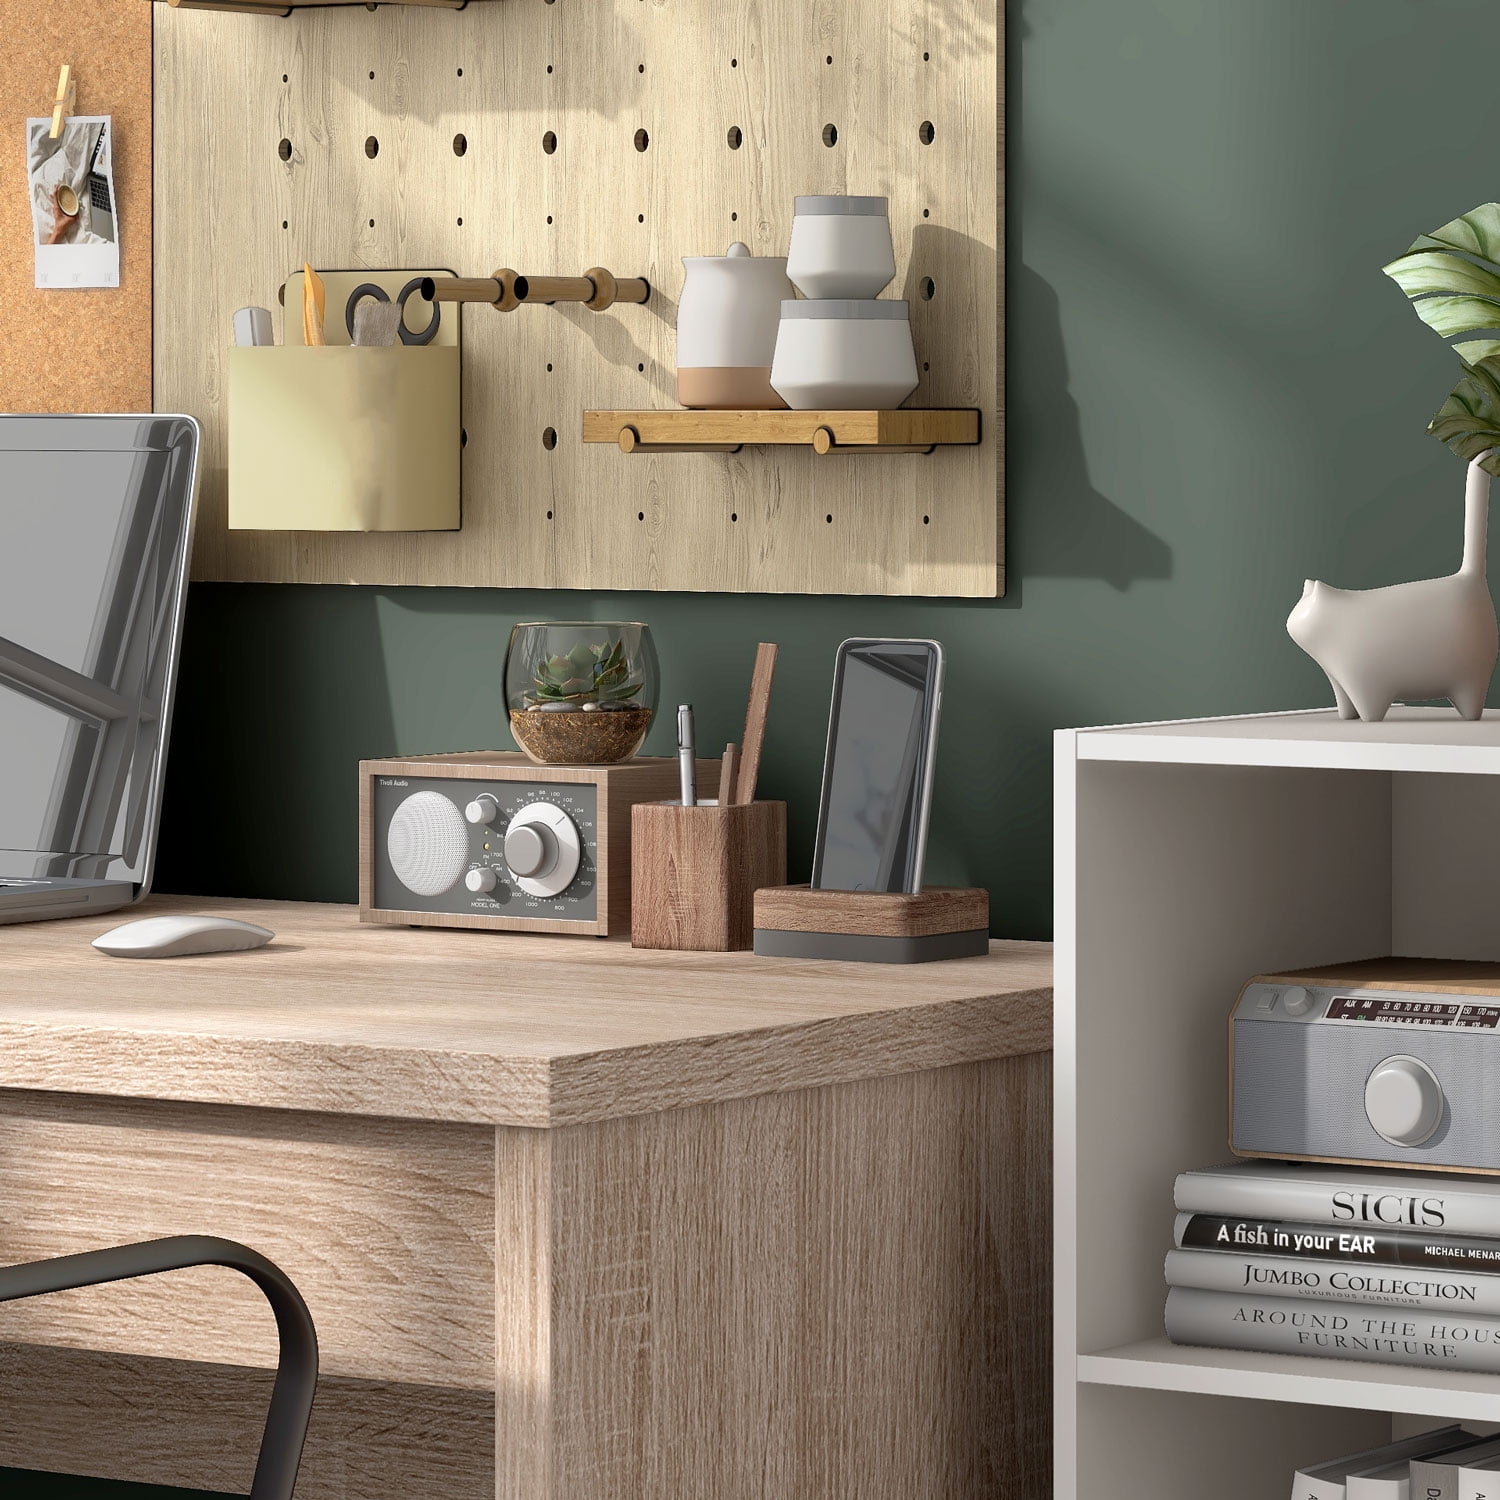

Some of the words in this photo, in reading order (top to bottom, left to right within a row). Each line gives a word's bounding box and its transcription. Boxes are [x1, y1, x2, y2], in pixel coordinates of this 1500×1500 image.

[1343, 1000, 1358, 1008] AUX
[1361, 1001, 1373, 1009] AM
[1331, 1190, 1446, 1228] SICIS
[1216, 1224, 1230, 1243] A
[1233, 1223, 1269, 1246] fish
[1273, 1228, 1289, 1247] in
[1293, 1234, 1334, 1252] your
[1338, 1233, 1376, 1254] EAR
[1424, 1245, 1466, 1259] MICHAEL
[1298, 1290, 1358, 1299] LUXURIOUS
[1362, 1295, 1422, 1305] FURNITURE
[1329, 1272, 1477, 1301] COLLECTION
[1232, 1306, 1348, 1331] AROUND
[1363, 1318, 1416, 1338] THE
[1297, 1331, 1457, 1359] FURNITURE
